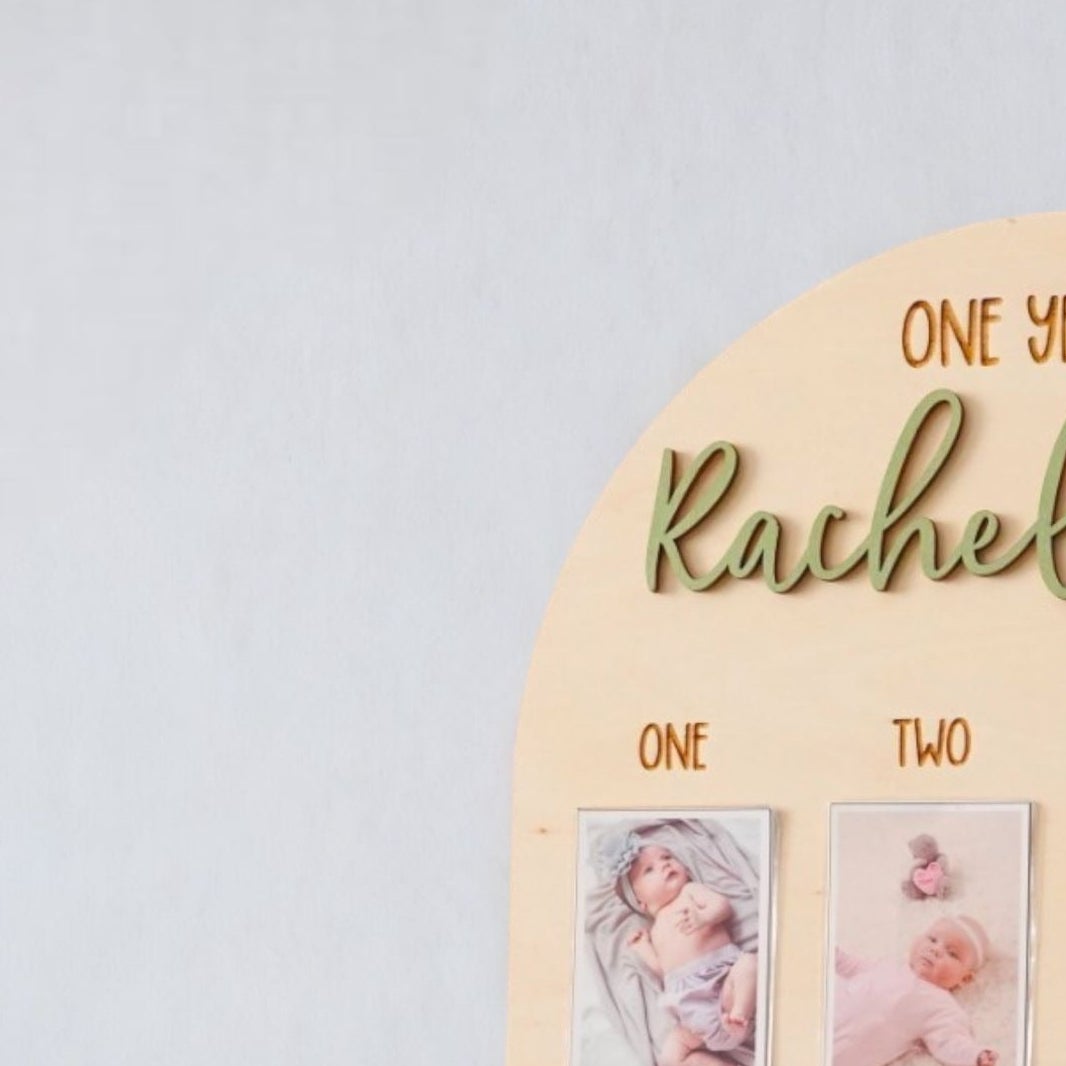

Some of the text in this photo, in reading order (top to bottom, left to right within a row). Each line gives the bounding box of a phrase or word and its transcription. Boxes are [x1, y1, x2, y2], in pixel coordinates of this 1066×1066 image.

[901, 296, 1003, 369] ONE
[638, 721, 709, 772] ONE
[891, 716, 972, 768] TWO
